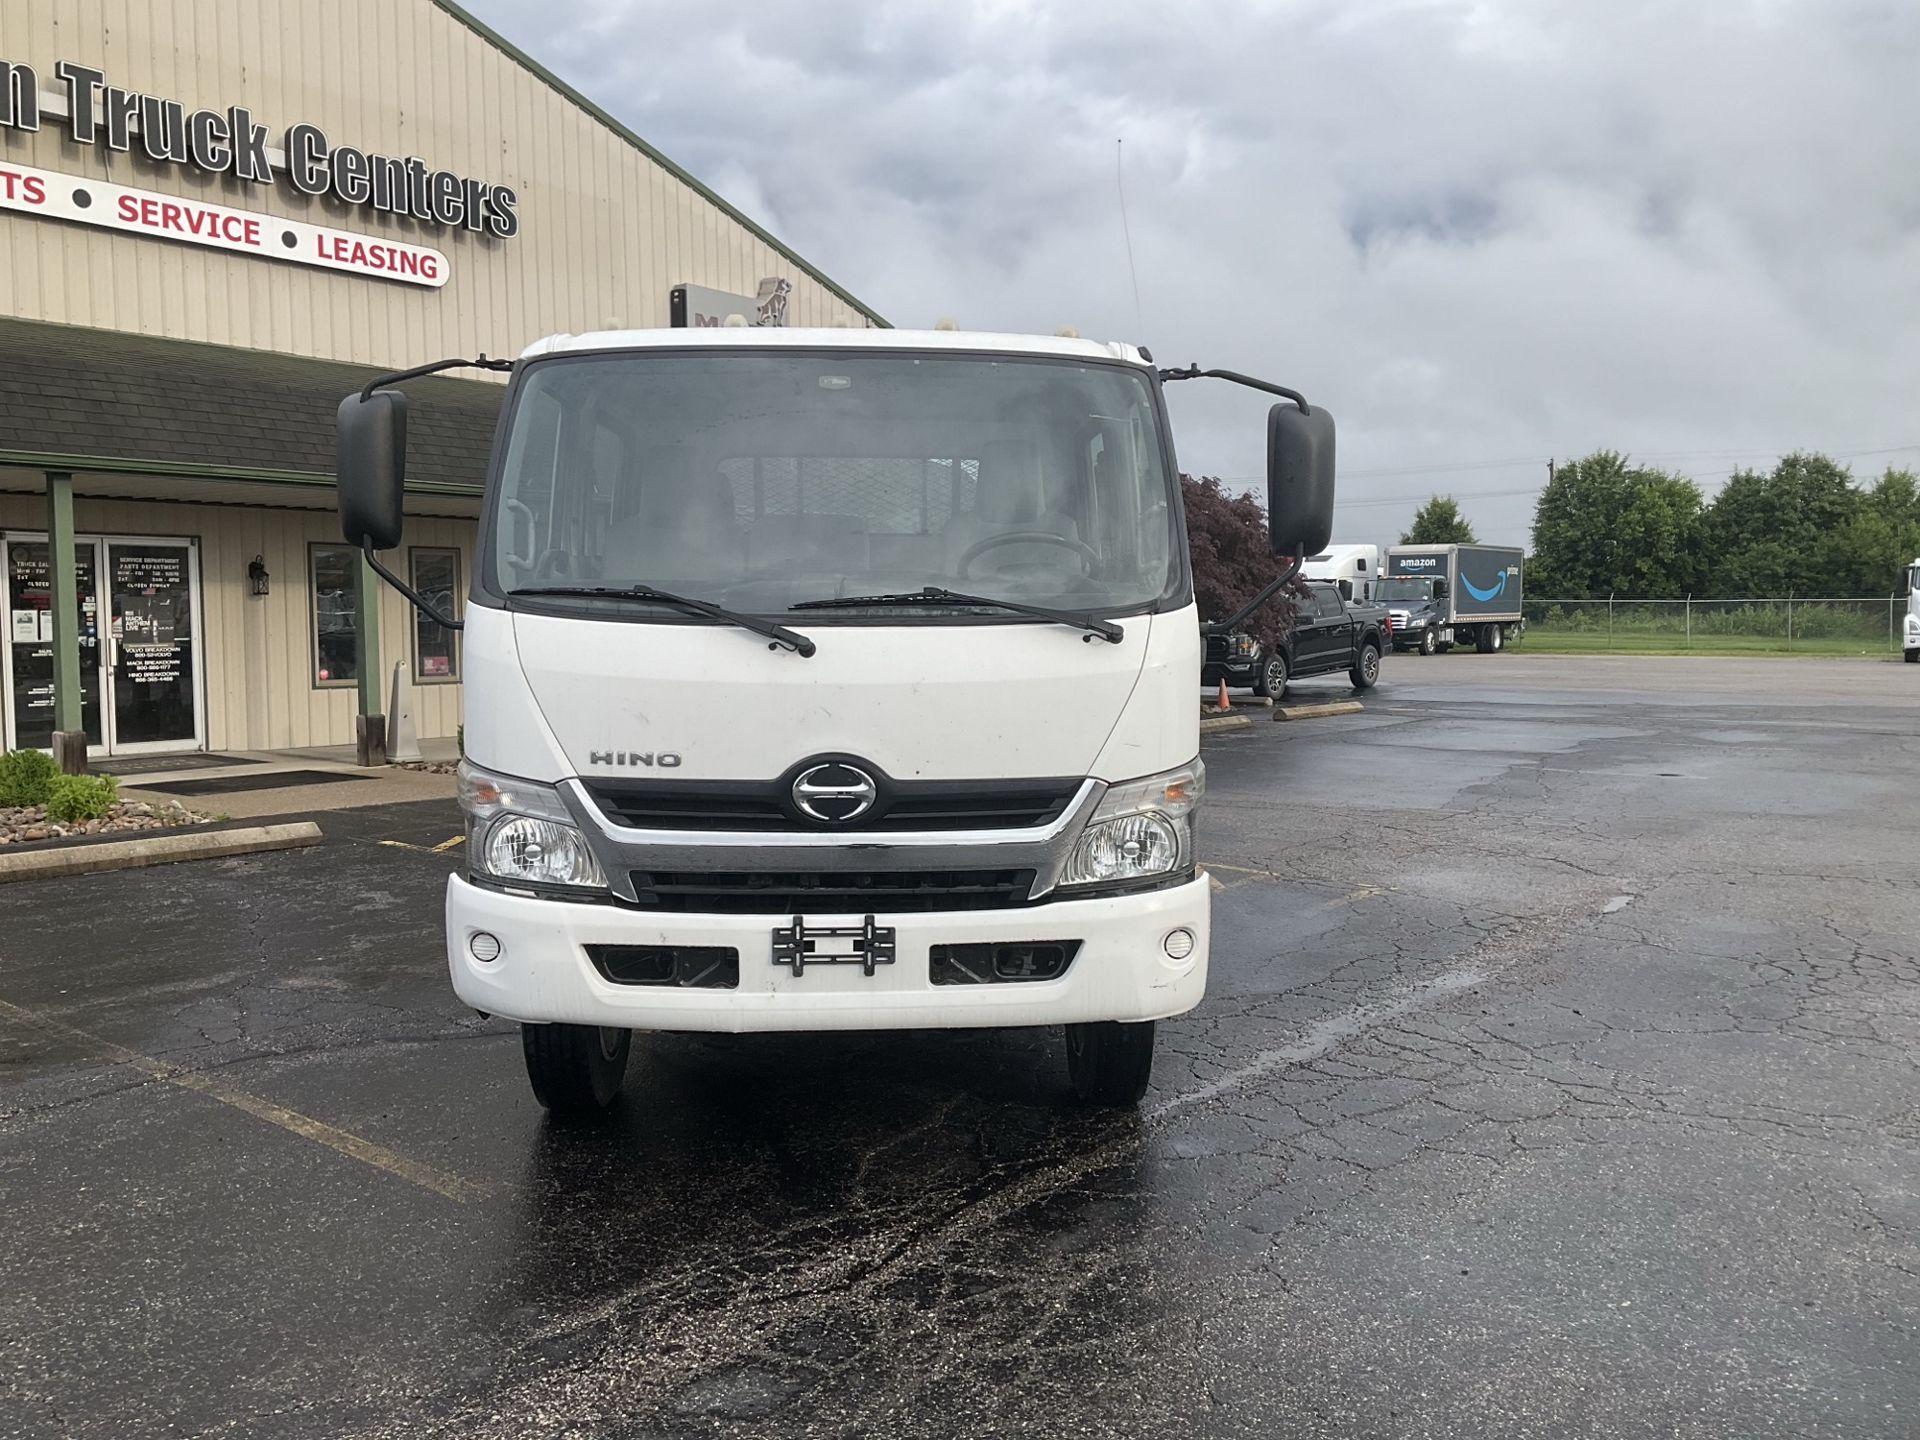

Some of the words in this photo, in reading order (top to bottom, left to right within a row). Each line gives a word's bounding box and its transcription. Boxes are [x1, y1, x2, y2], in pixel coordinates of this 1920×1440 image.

[56, 60, 274, 184] Truck
[285, 122, 519, 239] Centers
[117, 194, 261, 246] SERVICE
[317, 234, 438, 279] LEASING
[1400, 558, 1436, 567] amazon
[590, 751, 682, 767] HINO
